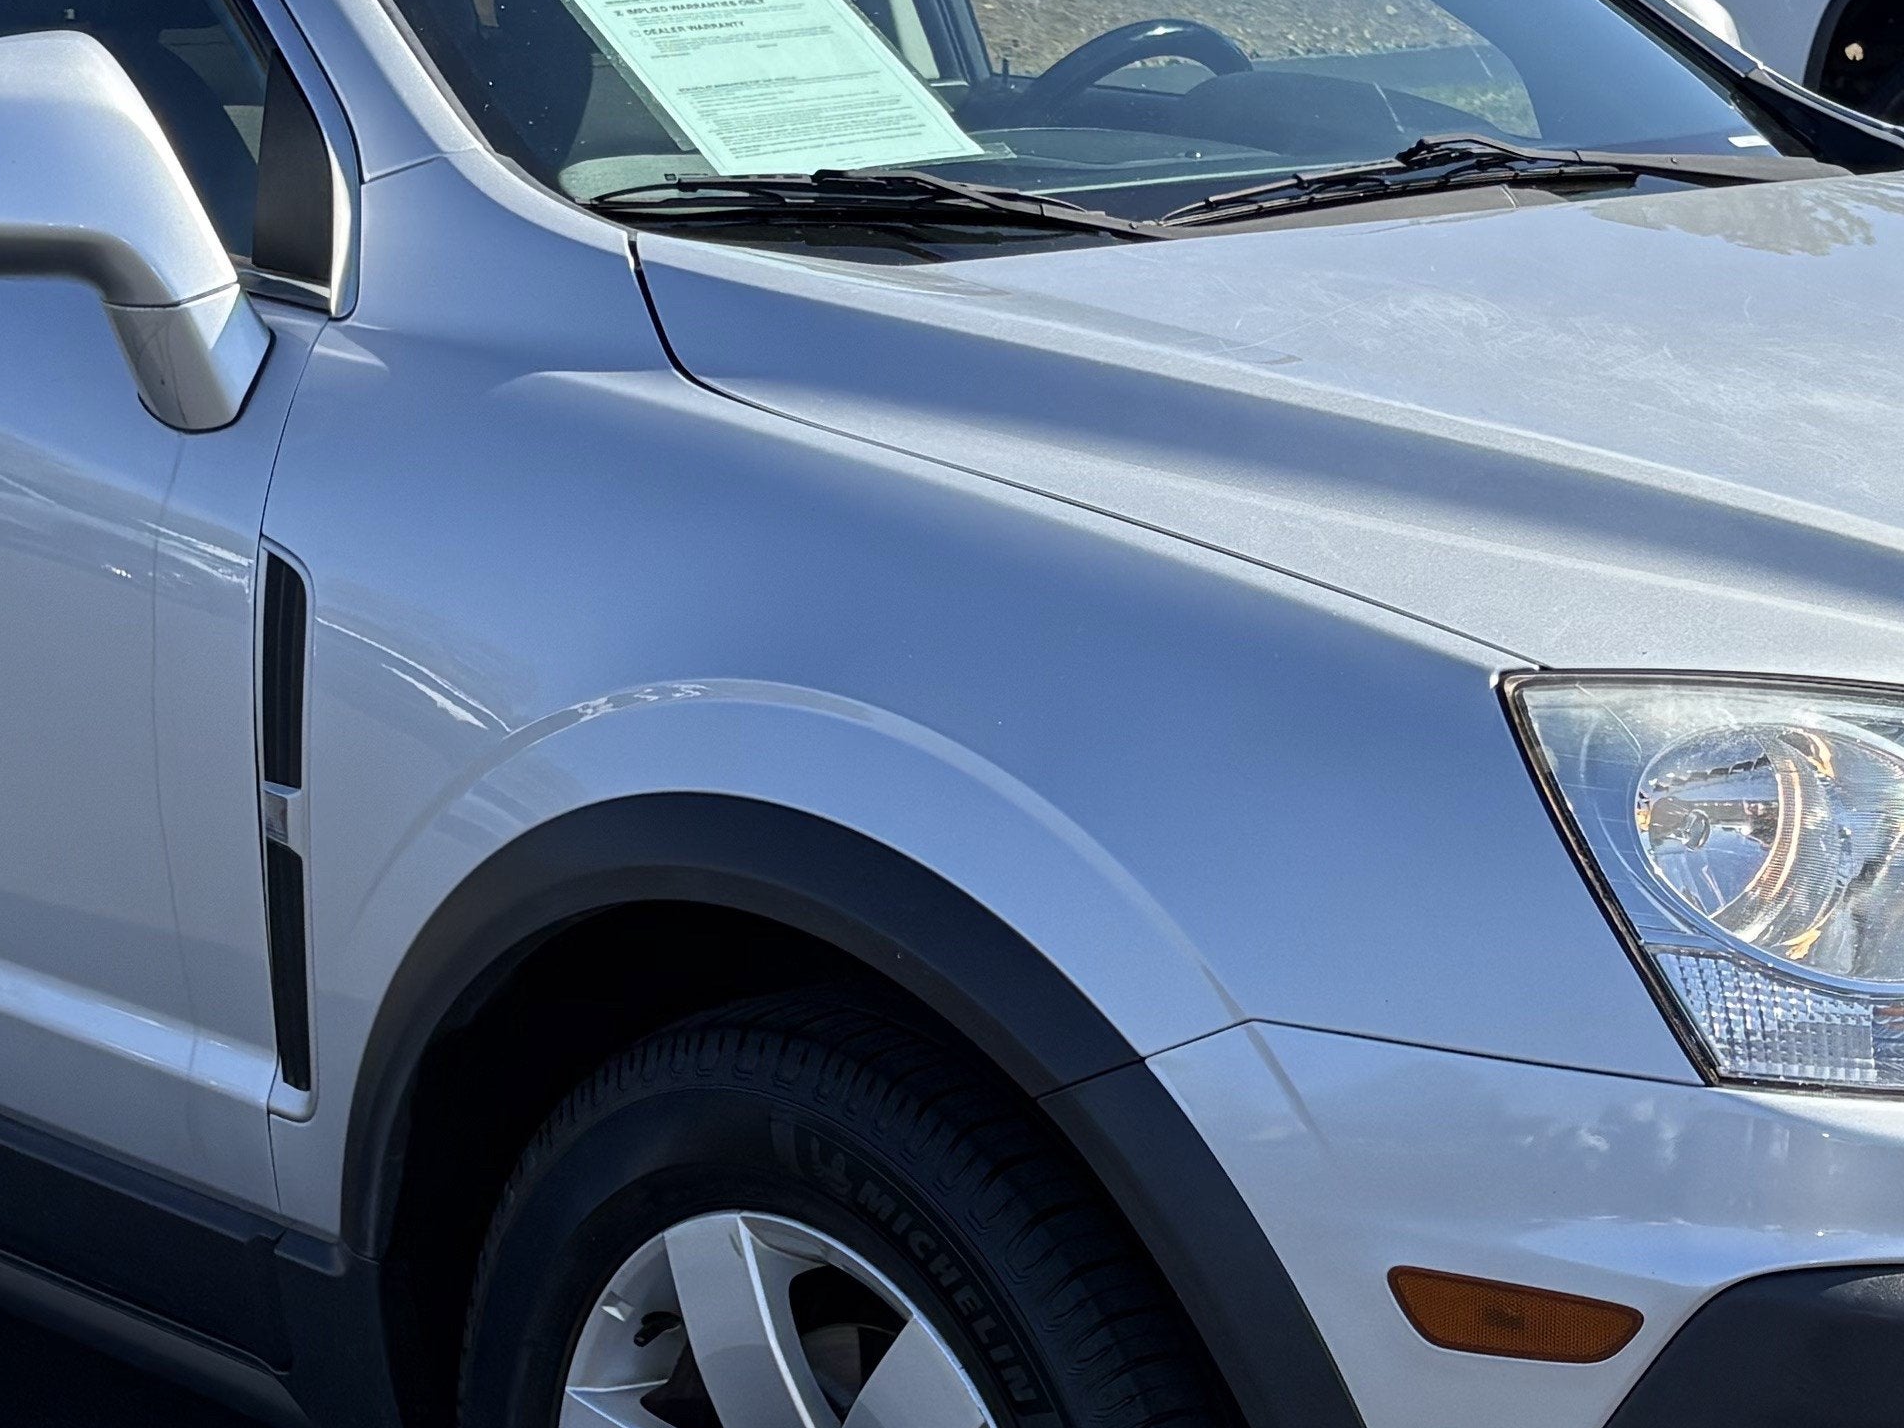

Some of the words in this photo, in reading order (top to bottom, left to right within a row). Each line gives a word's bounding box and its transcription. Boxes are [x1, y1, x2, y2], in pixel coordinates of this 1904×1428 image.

[626, 5, 668, 15] IMPLIED
[671, 0, 737, 12] WARRANTIES
[643, 25, 684, 36] DEALER
[687, 20, 745, 32] WARRANTY
[859, 1181, 1038, 1405] MICHELIN
